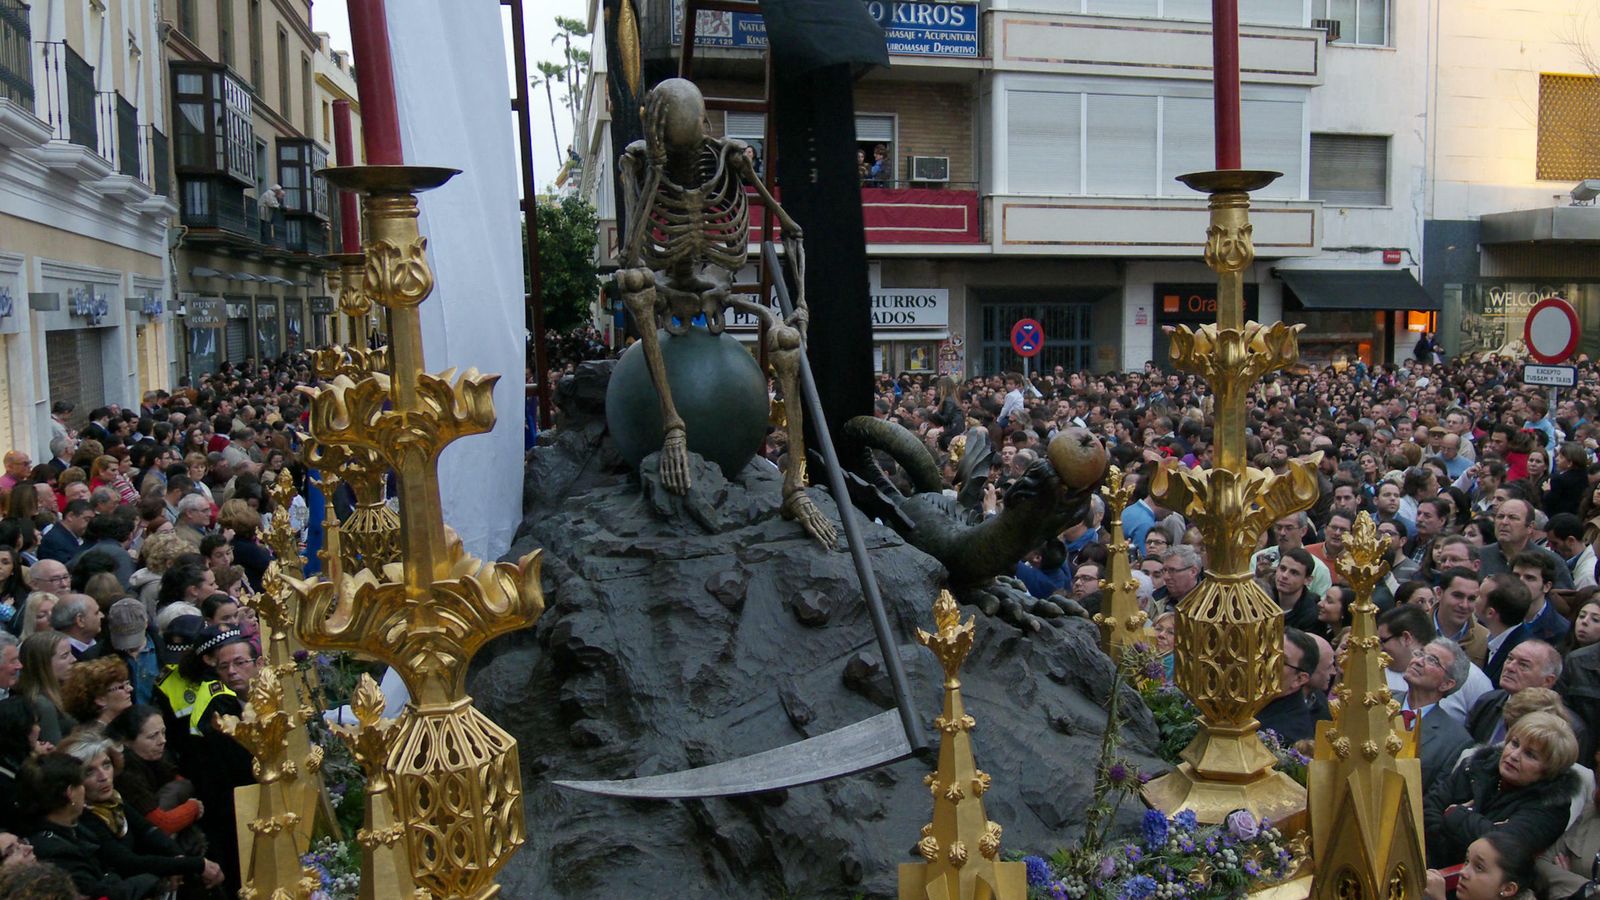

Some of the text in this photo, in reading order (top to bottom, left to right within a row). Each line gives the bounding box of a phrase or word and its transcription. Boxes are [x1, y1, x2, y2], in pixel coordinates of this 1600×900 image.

[891, 2, 965, 26] KIROS
[739, 23, 976, 42] NATUR MASAJE ACUPUNTURA
[746, 35, 975, 54] KINE UIROMASAJE DEPORTIVO
[871, 295, 937, 308] HURROS
[1188, 295, 1247, 312] Orae
[872, 311, 916, 324] ADOS
